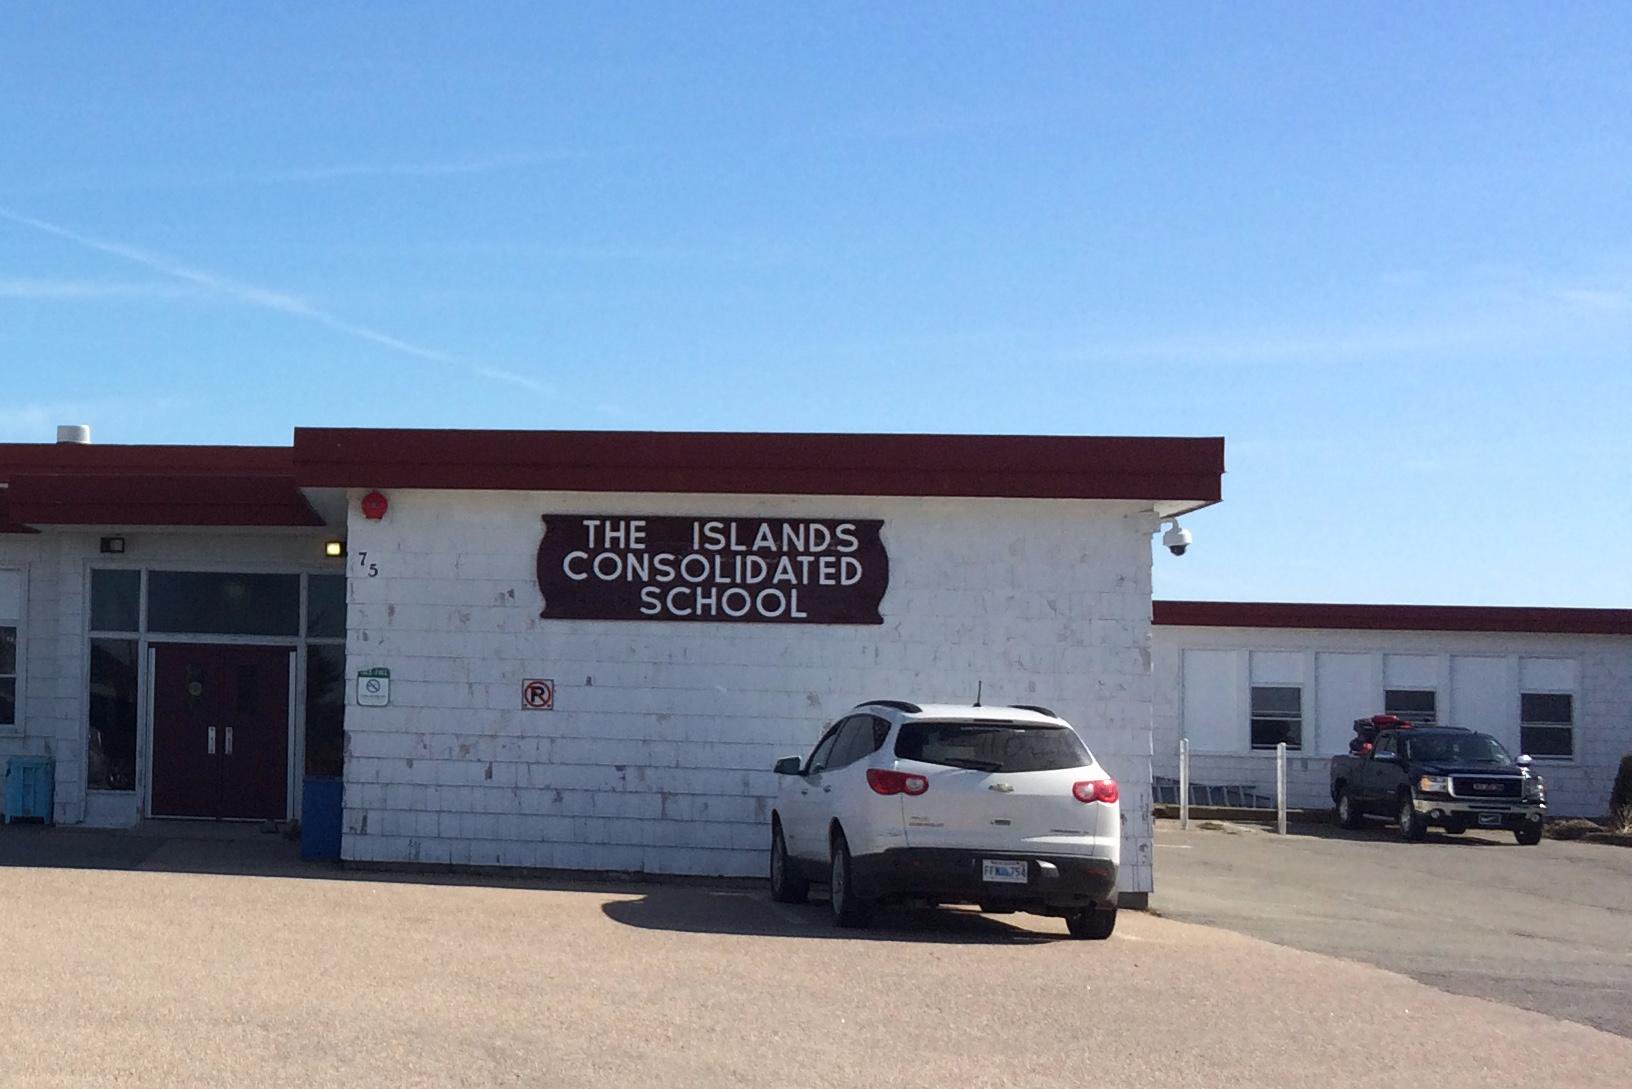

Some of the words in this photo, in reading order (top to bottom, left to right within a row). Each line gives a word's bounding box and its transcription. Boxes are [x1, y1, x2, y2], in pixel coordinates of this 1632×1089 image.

[582, 519, 647, 550] THE
[692, 520, 860, 554] ISLANDS
[562, 550, 863, 586] CONSOLIDATED
[639, 585, 808, 619] SCHOOL
